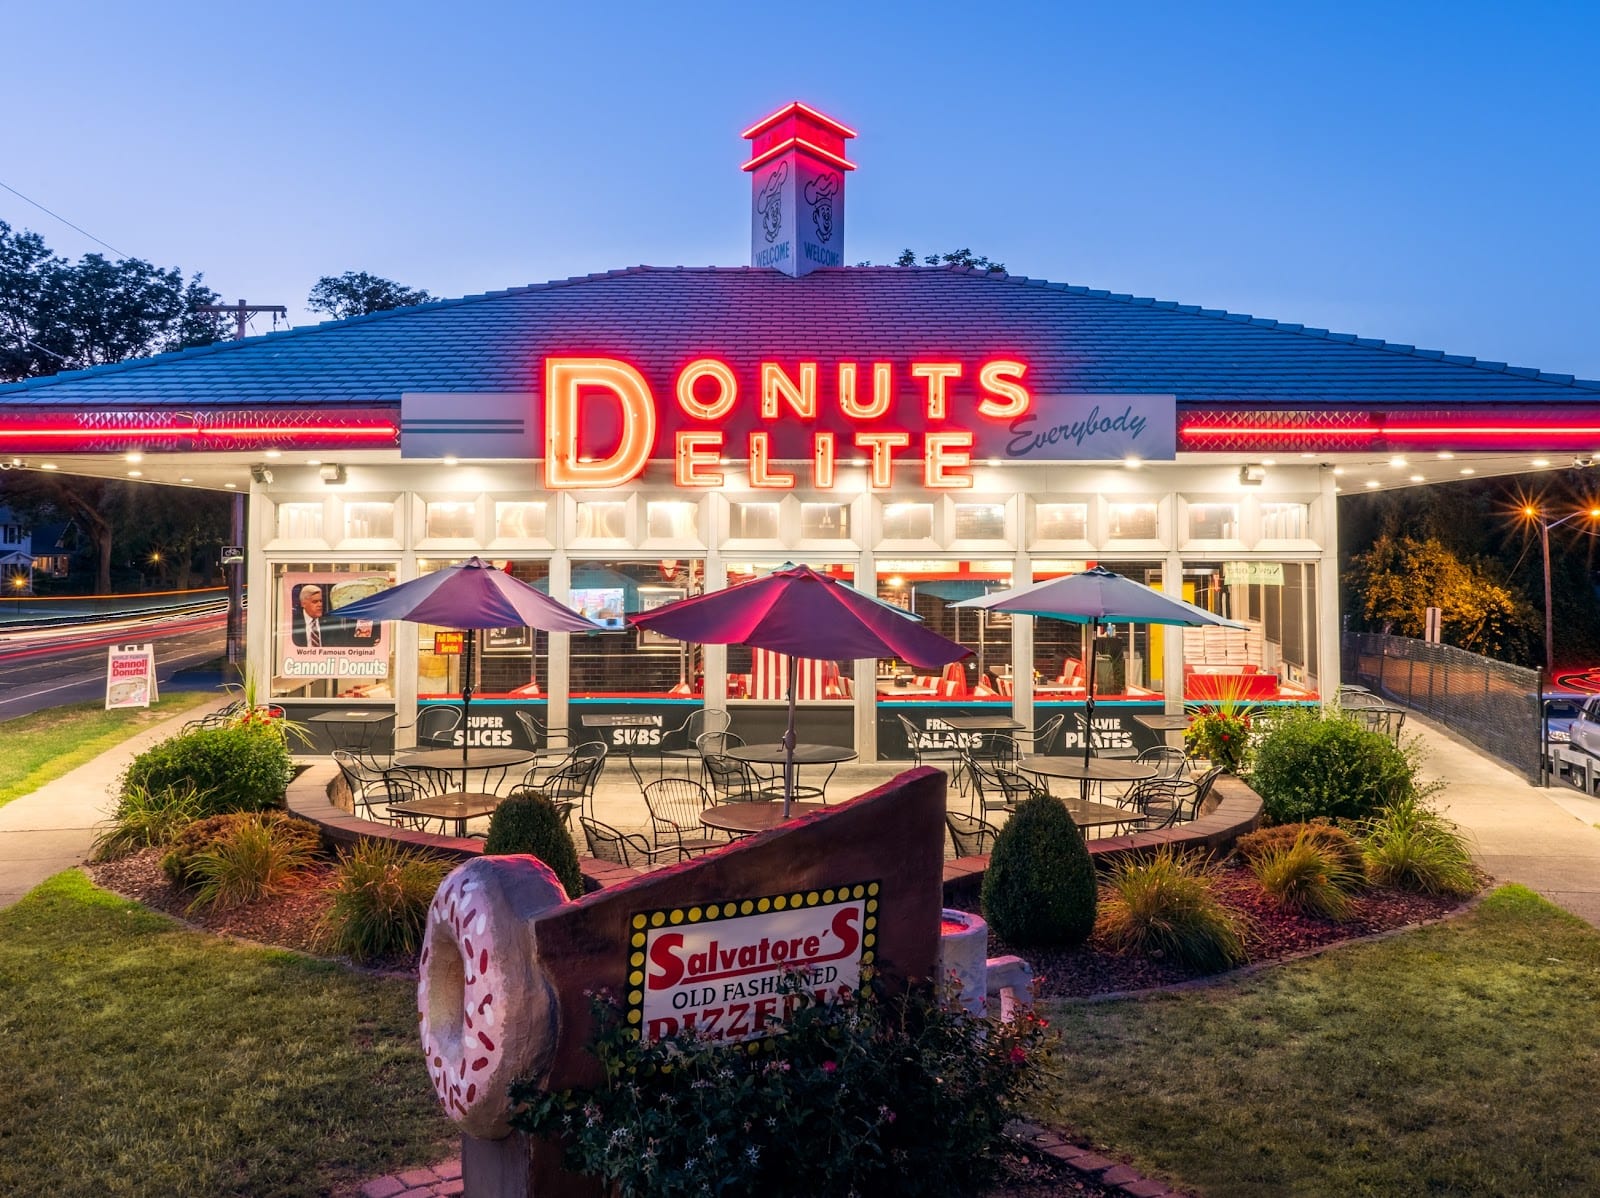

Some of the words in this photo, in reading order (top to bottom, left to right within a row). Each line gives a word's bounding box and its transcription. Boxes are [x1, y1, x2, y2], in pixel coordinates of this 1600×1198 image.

[755, 240, 790, 267] WELCOME
[804, 241, 840, 267] WELCOME
[1005, 405, 1147, 457] Everybody
[284, 657, 335, 675] Cannoli
[338, 657, 387, 675] Donuts
[453, 729, 513, 746] SLICES
[613, 729, 660, 745] SUBS
[672, 987, 716, 1010] OLD
